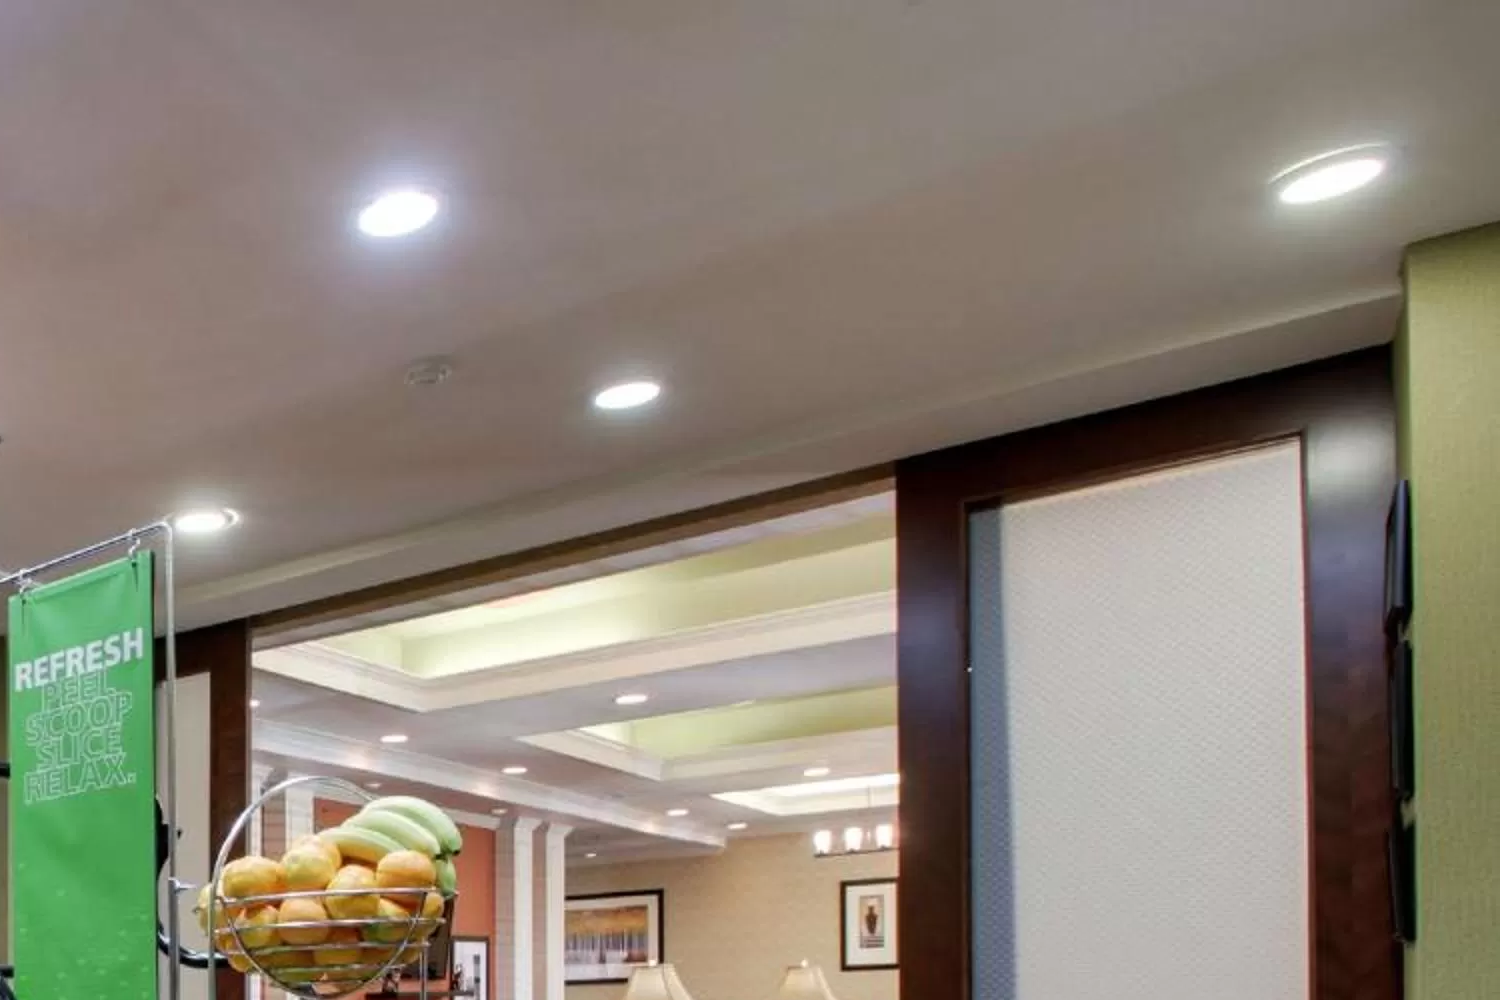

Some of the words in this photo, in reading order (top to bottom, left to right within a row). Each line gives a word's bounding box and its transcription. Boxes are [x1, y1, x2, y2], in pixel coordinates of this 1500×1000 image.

[14, 627, 144, 692] REFRESH
[42, 667, 117, 713] PEEL
[25, 691, 133, 748] SCOOP
[36, 720, 122, 773] SLICE
